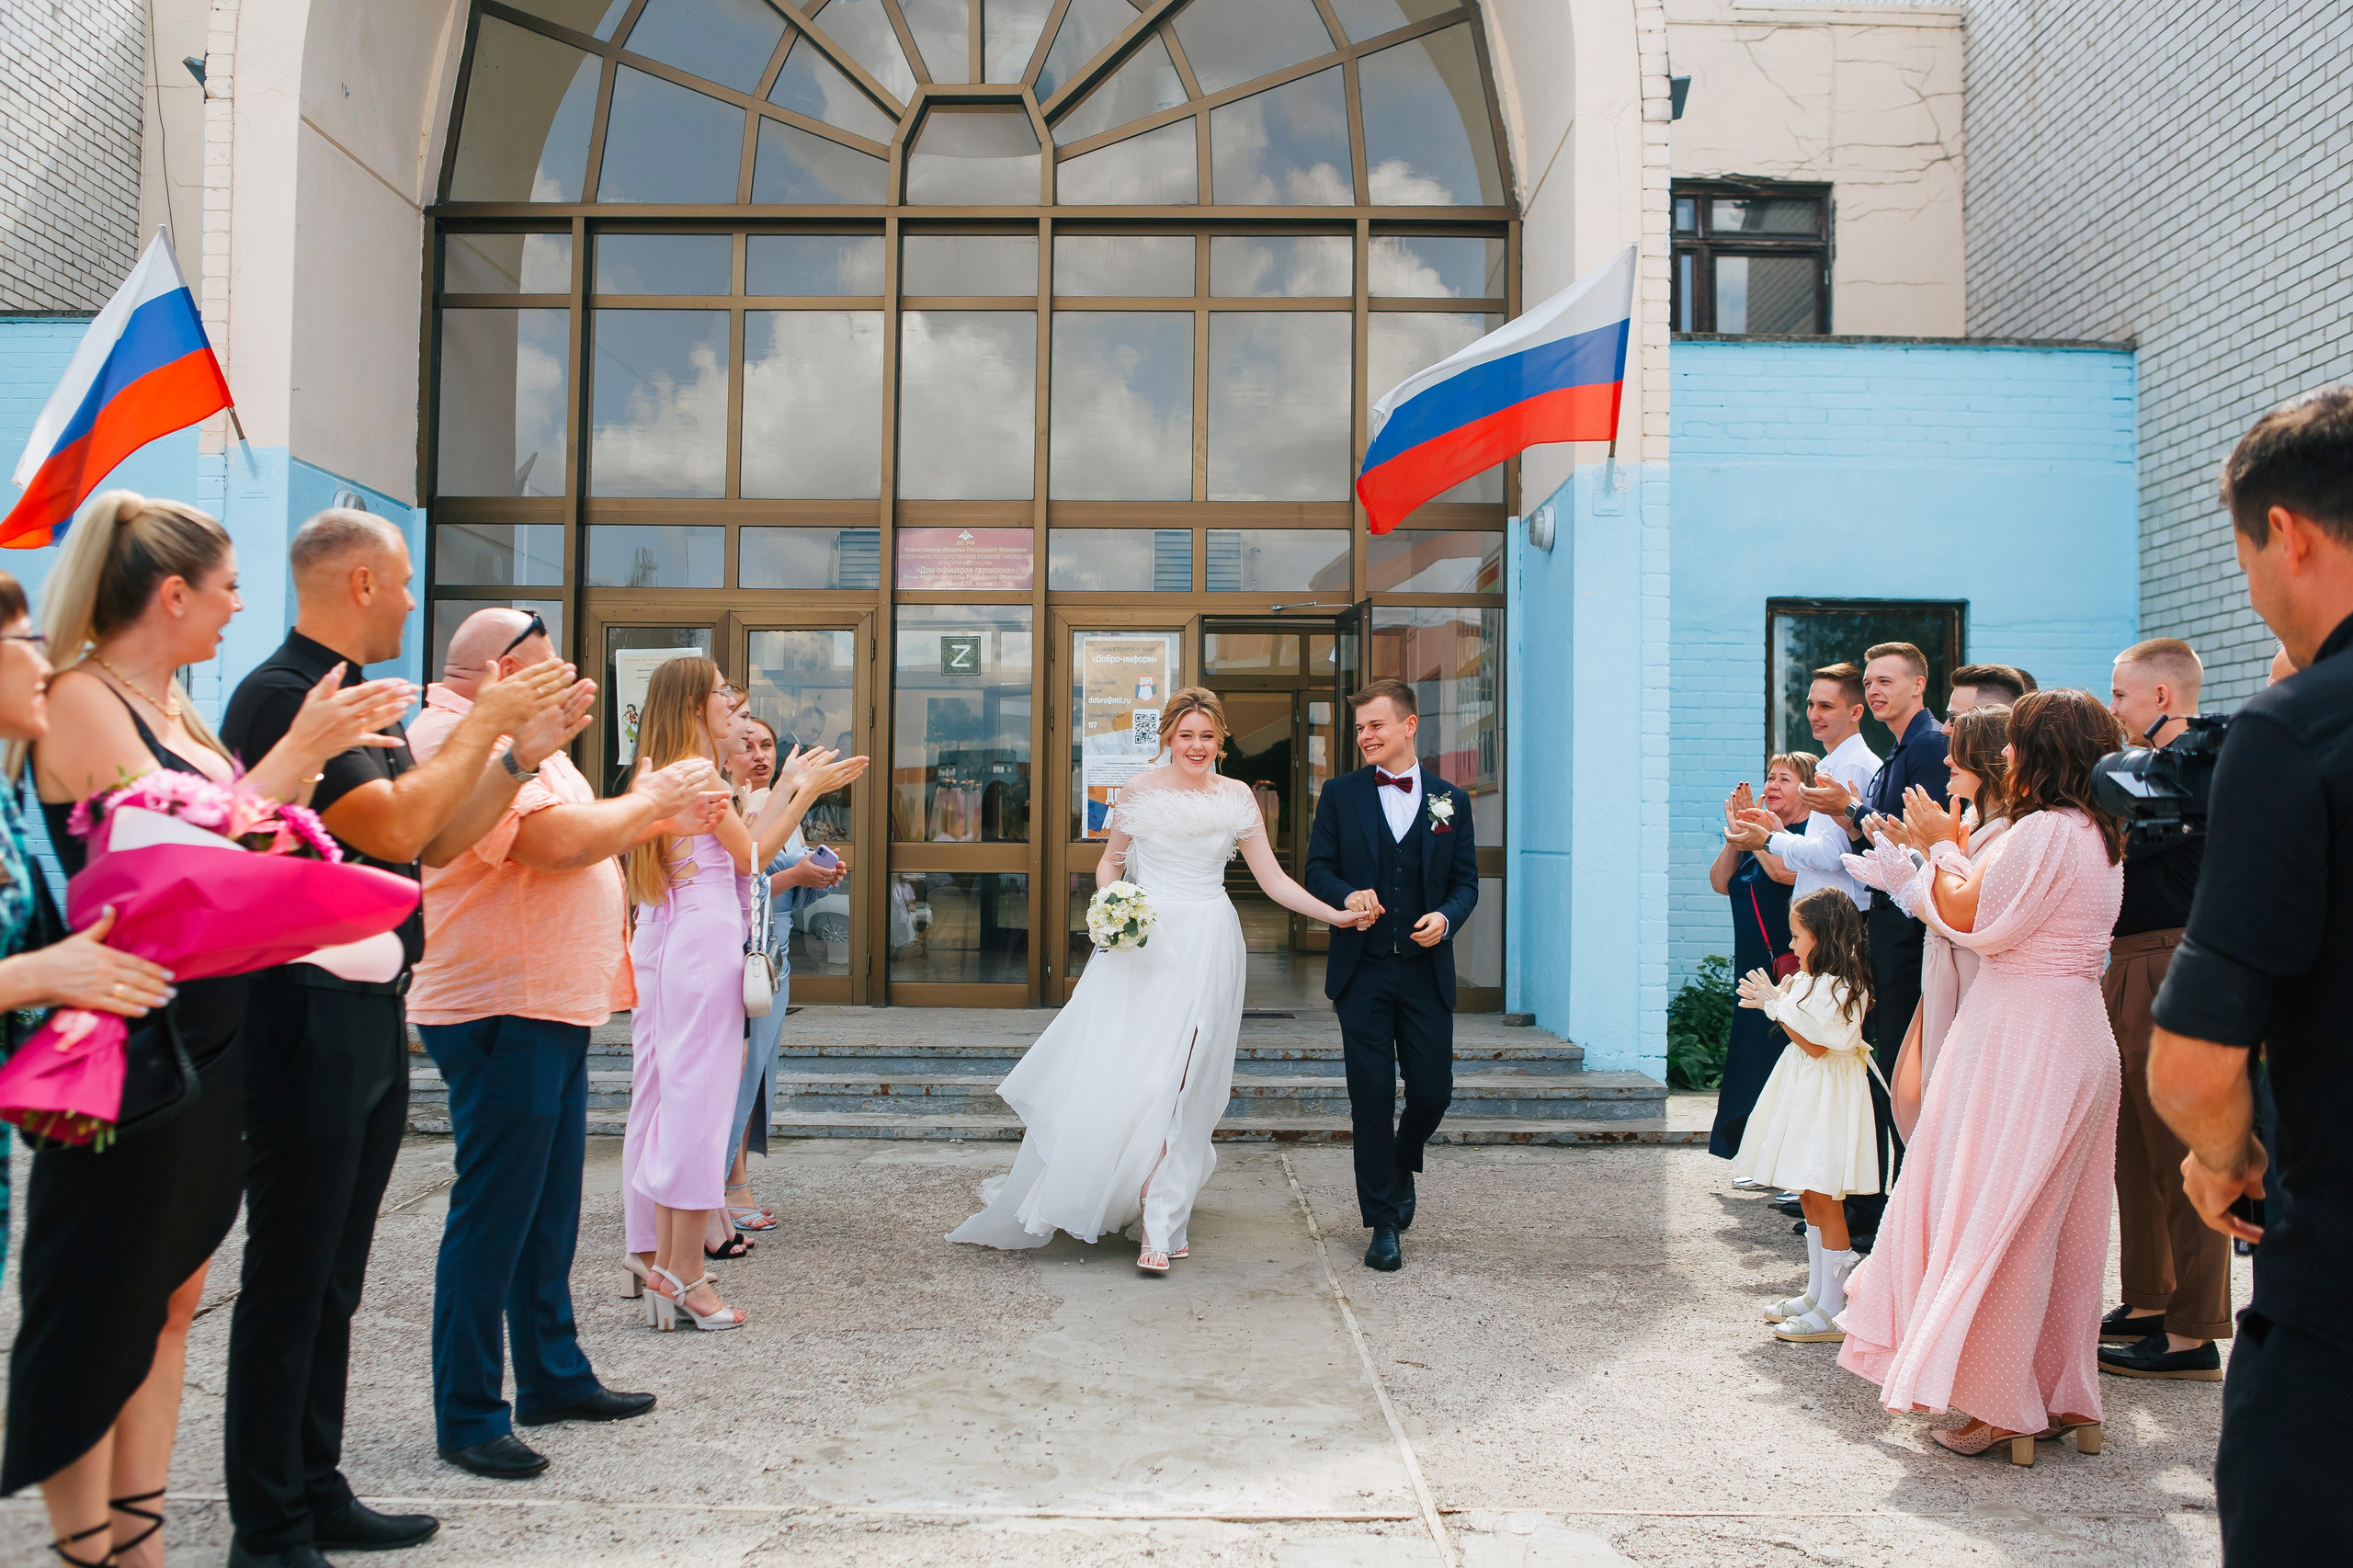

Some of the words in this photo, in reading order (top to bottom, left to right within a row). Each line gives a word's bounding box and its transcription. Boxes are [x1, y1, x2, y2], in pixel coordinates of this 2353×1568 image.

[916, 566, 936, 574] «Дом
[937, 566, 973, 575] офицеров
[974, 567, 1015, 575] гарнизона»
[950, 644, 972, 667] Z
[1091, 654, 1157, 665] «Добро-информ»
[1087, 696, 1131, 705] dobro@mil.ru
[1087, 721, 1098, 729] 117
